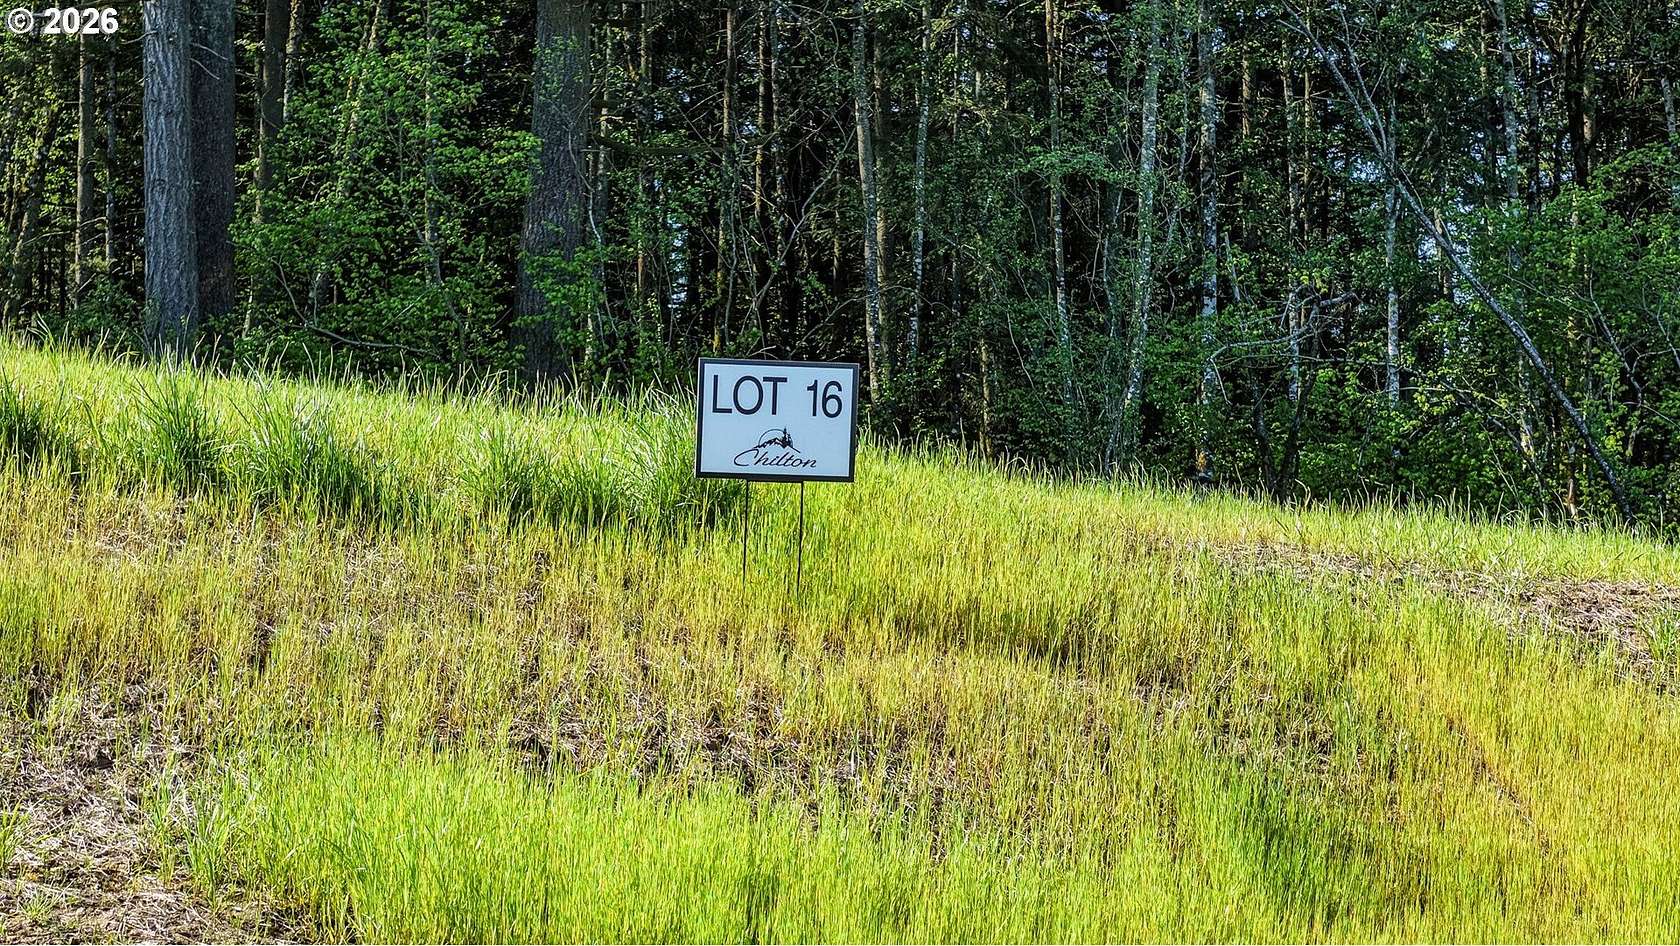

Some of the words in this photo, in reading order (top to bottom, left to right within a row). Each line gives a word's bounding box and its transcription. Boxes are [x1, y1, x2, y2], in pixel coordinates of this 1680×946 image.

[711, 374, 788, 417] LOT
[806, 379, 843, 419] 16
[733, 447, 817, 469] Chilton
